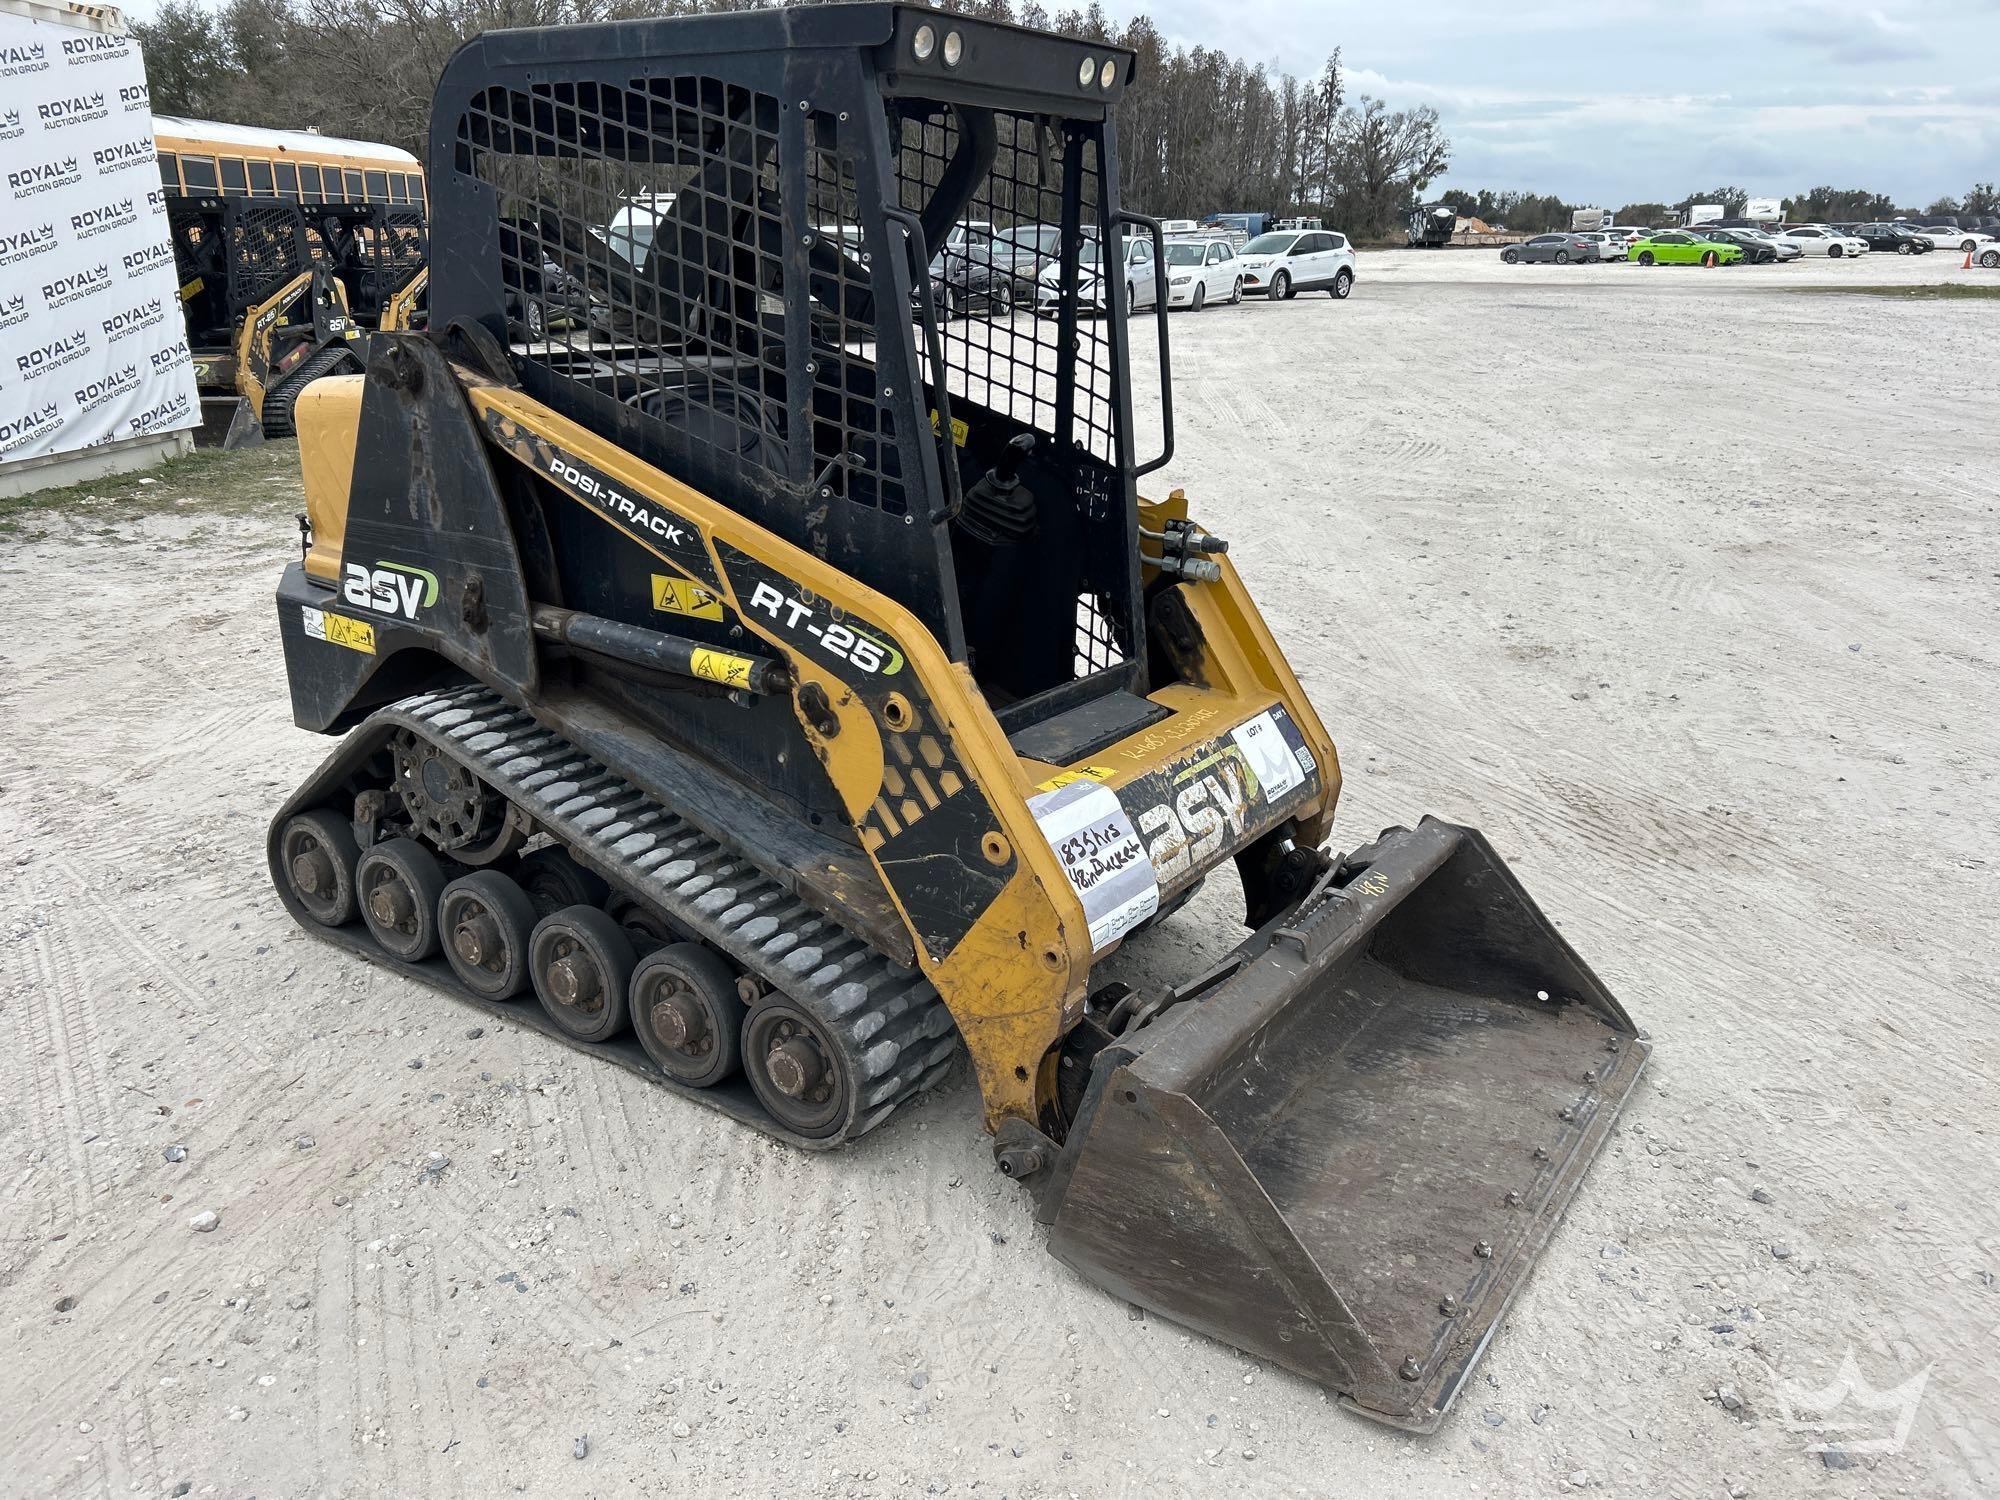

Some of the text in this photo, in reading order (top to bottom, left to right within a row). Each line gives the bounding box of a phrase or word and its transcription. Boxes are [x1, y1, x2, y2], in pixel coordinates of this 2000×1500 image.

[62, 35, 114, 54] ROYAL
[19, 62, 49, 74] GROUP
[68, 49, 129, 66] AUCTION GROUP
[38, 97, 93, 119] ROYAL
[44, 110, 108, 130] AUCTION GROUP
[93, 142, 141, 165] ROYAL
[99, 153, 155, 175] AUCTION GROUP
[8, 162, 65, 188] ROYAL
[14, 174, 81, 199] AUCTION GROUP
[71, 204, 122, 229] ROYAL
[77, 214, 137, 240] AUCTION GROUP
[29, 241, 58, 256] GROUP
[122, 243, 168, 269] ROYAL
[128, 261, 159, 279] AUCTION
[42, 271, 96, 300] ROYAL
[48, 280, 113, 310] AUCTION GROUP
[102, 305, 150, 334] ROYAL
[108, 313, 165, 344] AUCTION GROUP
[16, 338, 74, 371] ROYAL
[23, 346, 91, 381] AUCTION GROUP
[155, 356, 185, 376] AUCTION
[74, 372, 125, 404] ROYAL
[82, 379, 141, 414] AUCTION GROUP
[130, 400, 177, 431] ROYAL
[167, 406, 191, 424] GROUP
[34, 418, 64, 438] GROUP
[550, 458, 684, 545] POSI-TRACK
[750, 582, 885, 675] RT-25
[1272, 710, 1283, 720] DAY
[1246, 724, 1259, 738] LOT
